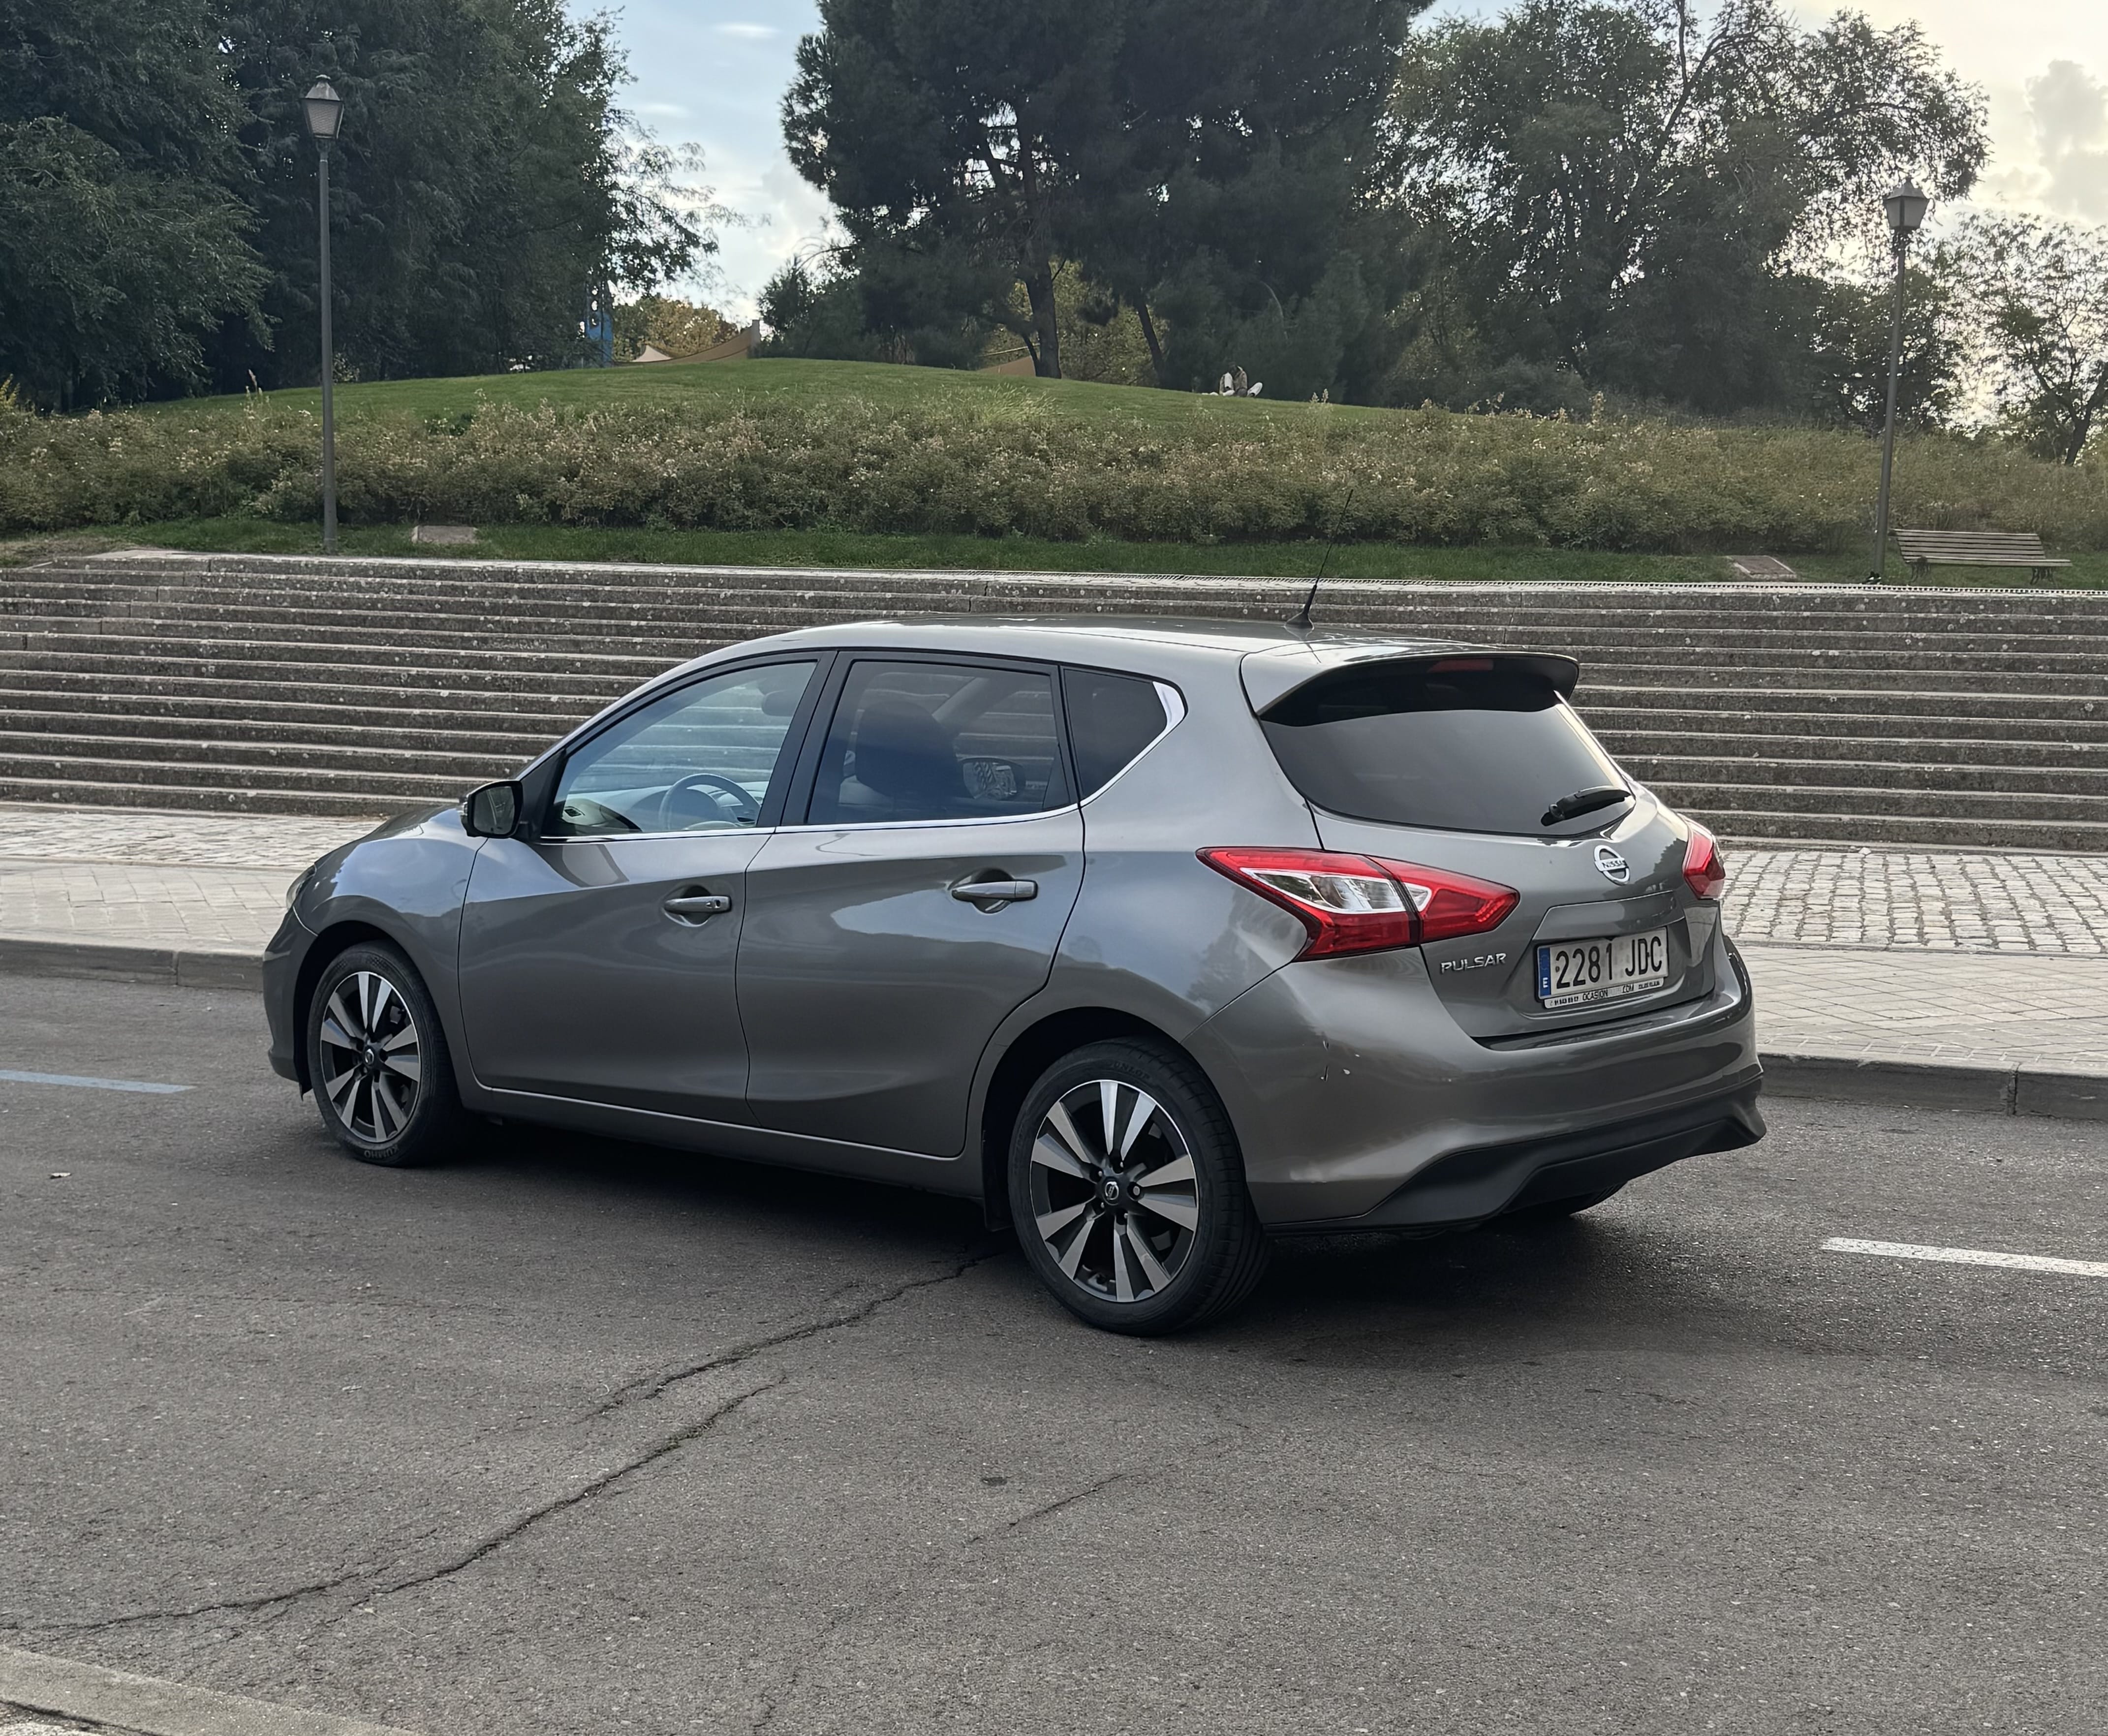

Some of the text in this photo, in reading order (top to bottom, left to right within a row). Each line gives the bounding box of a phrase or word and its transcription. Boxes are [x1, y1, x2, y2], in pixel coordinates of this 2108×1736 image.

[1441, 953, 1506, 973] PULSAR
[1556, 936, 1662, 989] 2281 JDC
[1543, 977, 1549, 988] E
